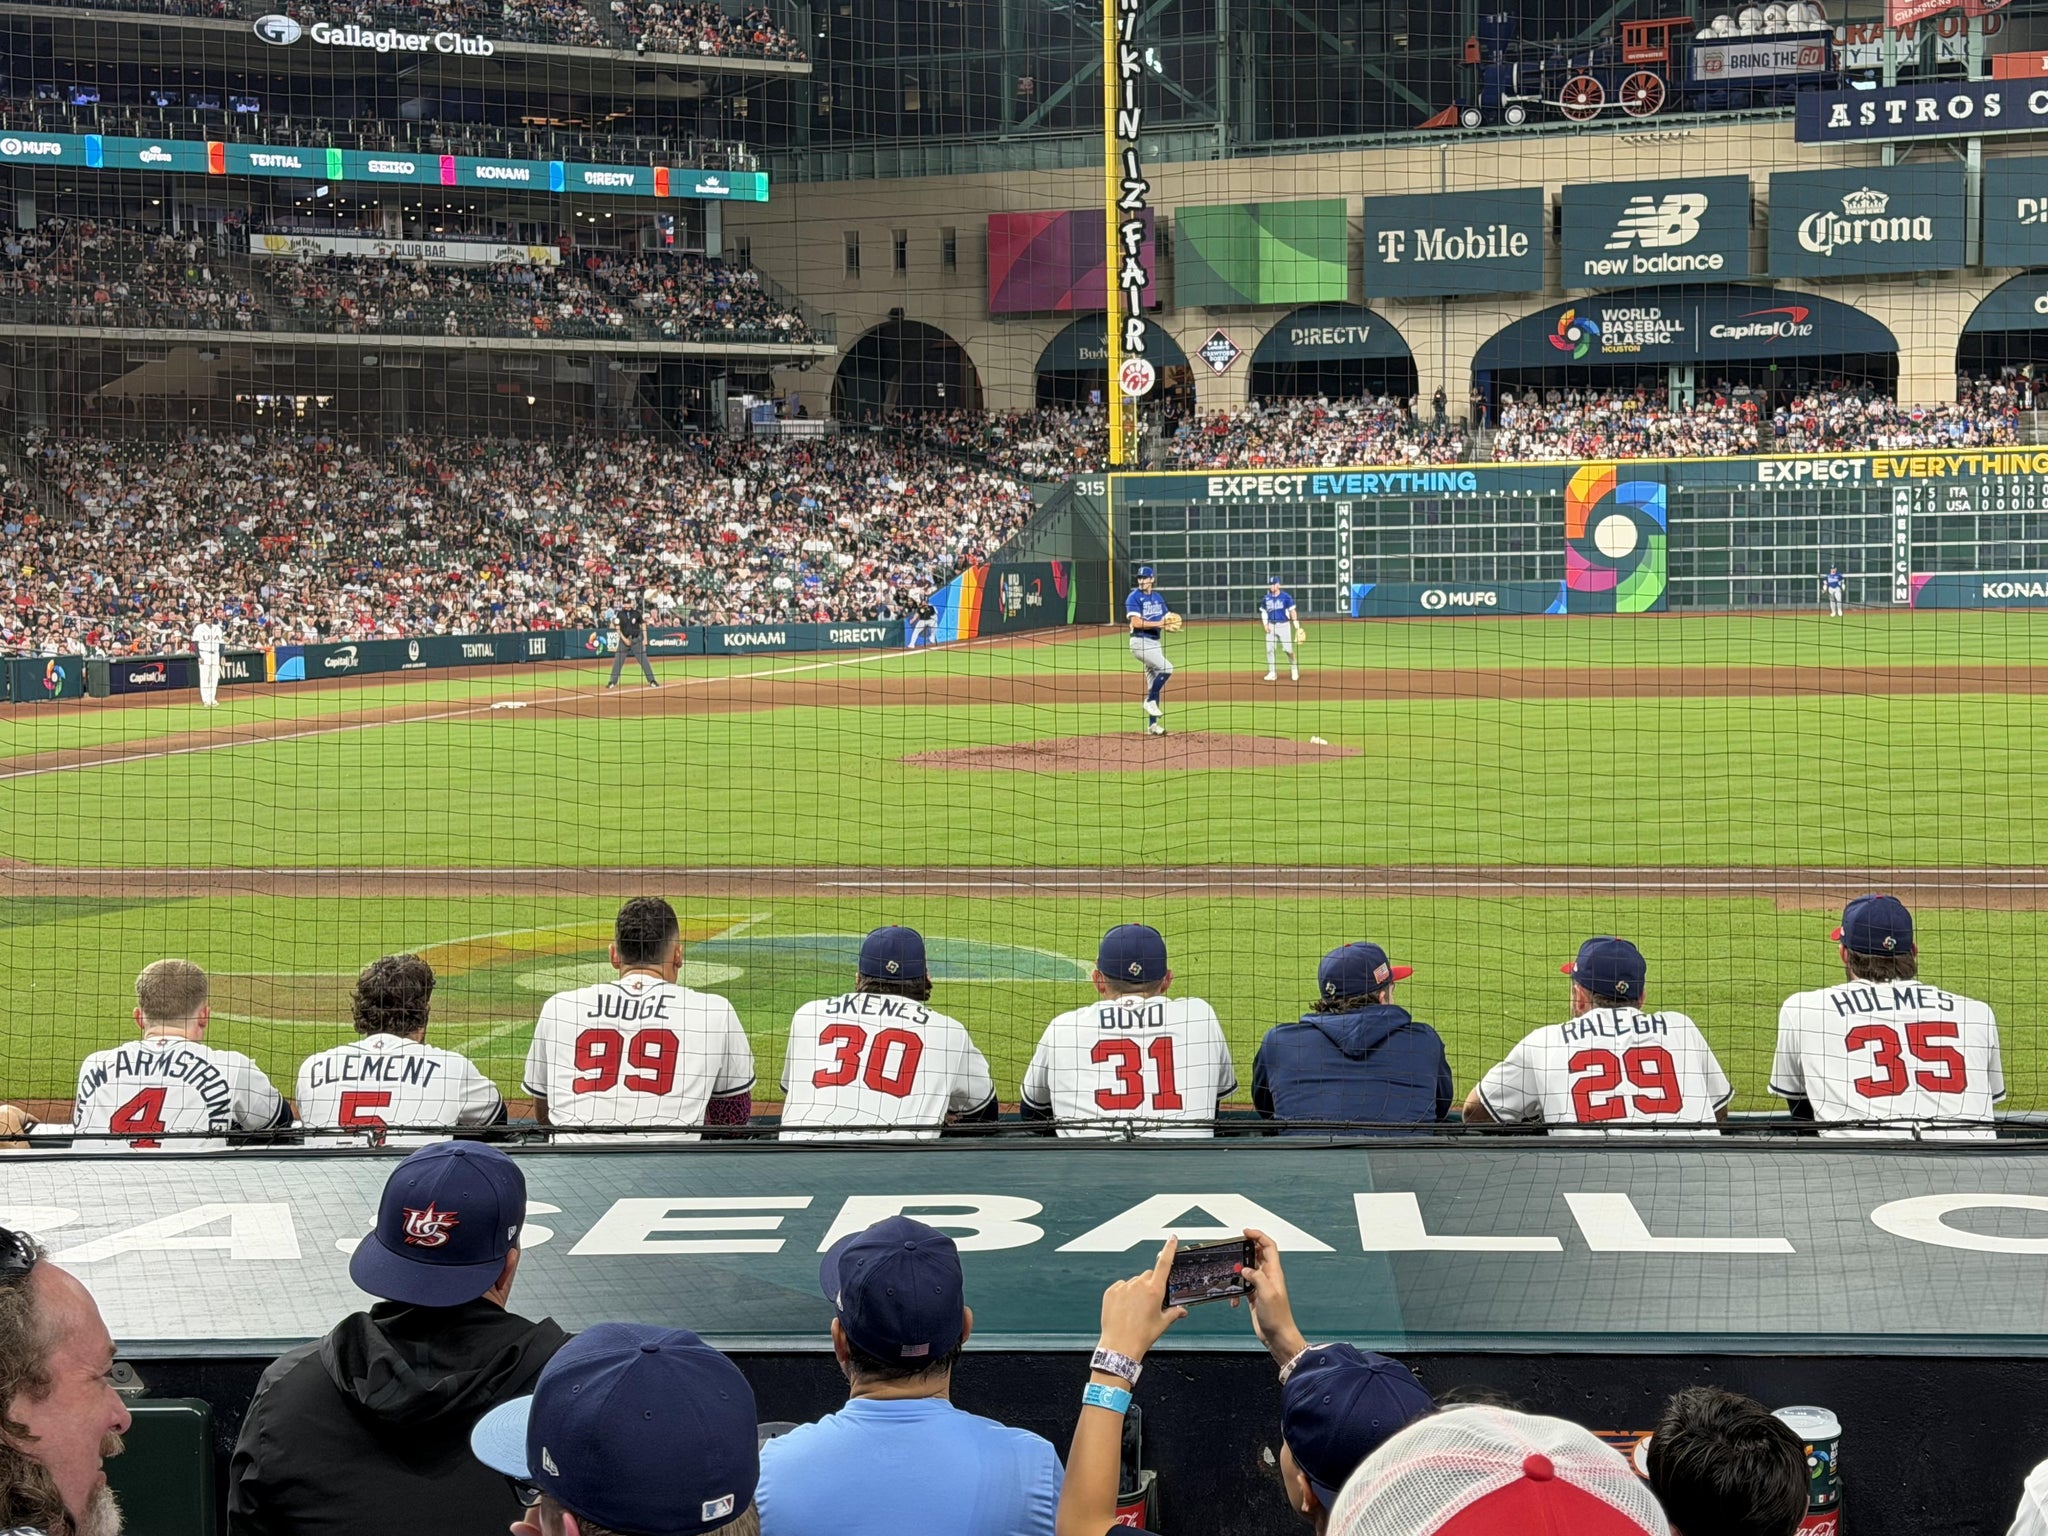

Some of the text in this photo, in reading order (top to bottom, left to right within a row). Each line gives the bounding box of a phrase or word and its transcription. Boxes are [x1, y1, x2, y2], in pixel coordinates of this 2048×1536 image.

[311, 22, 494, 56] Gallagher Club
[1730, 52, 1770, 69] BRING
[1772, 50, 1798, 66] THE
[1799, 48, 1820, 64] GO
[1827, 93, 2001, 128] ASTROS
[22, 141, 62, 155] MUFG
[250, 153, 302, 169] TENTIAL
[368, 160, 415, 175] SEIKO
[476, 166, 530, 182] KONAMI
[584, 171, 635, 187] DIRECTV
[1119, 0, 1147, 352] IKIN IZ FAIR
[1414, 224, 1529, 262] Mobile
[1798, 211, 1933, 256] Corona
[395, 243, 446, 258] CLUB BAR
[1584, 253, 1724, 276] new balance
[1601, 307, 1661, 321] WORLD
[1291, 326, 1371, 346] DIRECTV
[1602, 319, 1682, 334] BASEBALL
[1601, 331, 1672, 346] CLASSIC
[1601, 345, 1641, 353] HOUSTON
[1758, 453, 2048, 482] EXPECT EVERYTHING
[1075, 481, 1105, 496] 315
[1208, 471, 1477, 497] EXPECT EVERYTHING
[1950, 487, 1968, 498] ITA
[1982, 485, 1989, 497] 0
[1996, 485, 2004, 497] 3
[2011, 485, 2019, 496] 0
[2027, 484, 2035, 496] 2
[1914, 501, 1936, 512] 4 0
[1946, 501, 1971, 511] USA
[1982, 500, 1989, 511] 0
[1996, 499, 2005, 510] 0
[2011, 499, 2020, 510] 0
[2027, 498, 2035, 509] 0
[1896, 490, 1908, 600] AMERICAN
[1339, 505, 1350, 610] NATIONAL
[1449, 592, 1497, 606] MUFG
[1983, 582, 2048, 598] KONA
[724, 631, 786, 647] KONAMI
[830, 627, 886, 643] DIRECTV
[462, 643, 495, 658] TENTIAL
[528, 637, 546, 655] IHI
[218, 660, 250, 679] NTIAL
[587, 994, 676, 1021] JUDGE
[826, 993, 932, 1025] SKENES
[1830, 986, 1954, 1018] HOLMES
[1099, 1003, 1164, 1030] BOYD
[572, 1028, 680, 1096] 99
[812, 1023, 924, 1098] 30
[1845, 1020, 1967, 1100] 35
[311, 1054, 441, 1089] CLEMENT
[1090, 1036, 1183, 1111] 31
[1568, 1046, 1684, 1123] 29
[110, 1087, 168, 1149] 4
[338, 1091, 392, 1145] 5
[0, 1193, 1797, 1263] AEBALL
